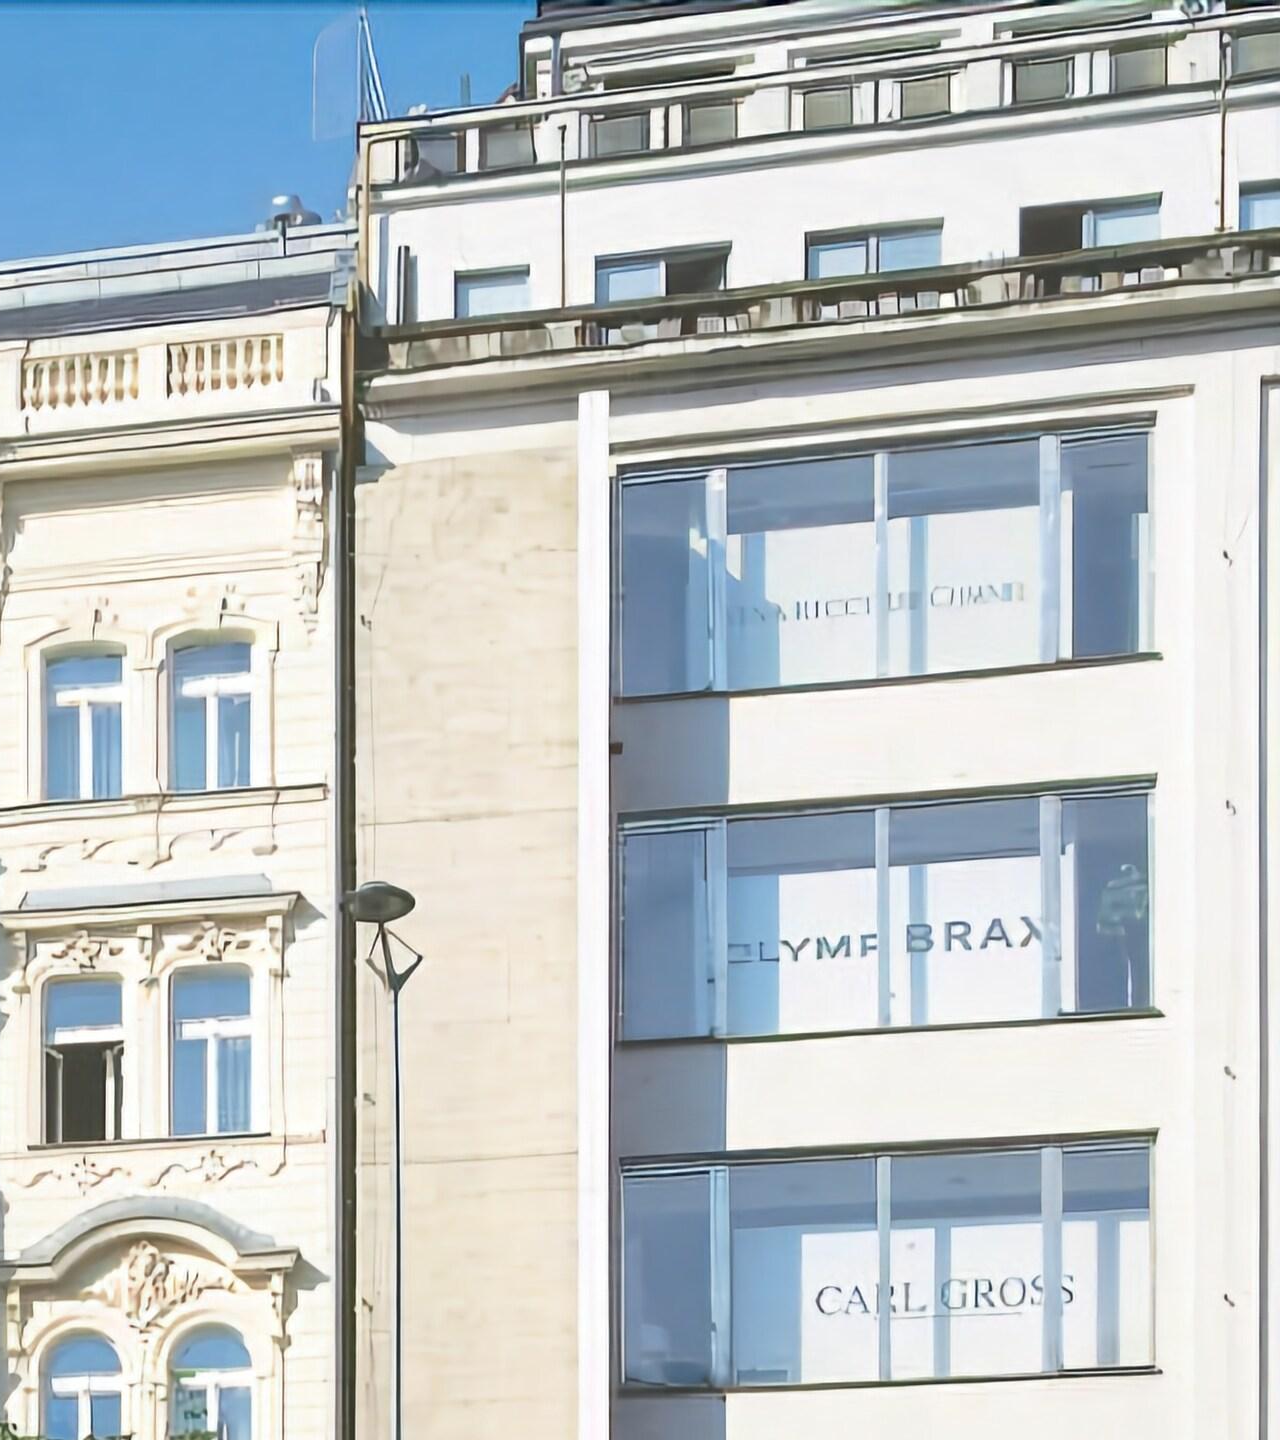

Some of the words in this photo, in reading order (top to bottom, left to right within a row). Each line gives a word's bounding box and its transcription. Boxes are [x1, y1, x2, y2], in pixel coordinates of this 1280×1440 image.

[905, 915, 1045, 954] BRAX
[814, 1281, 928, 1316] CARL
[940, 1273, 1075, 1310] GROSS
